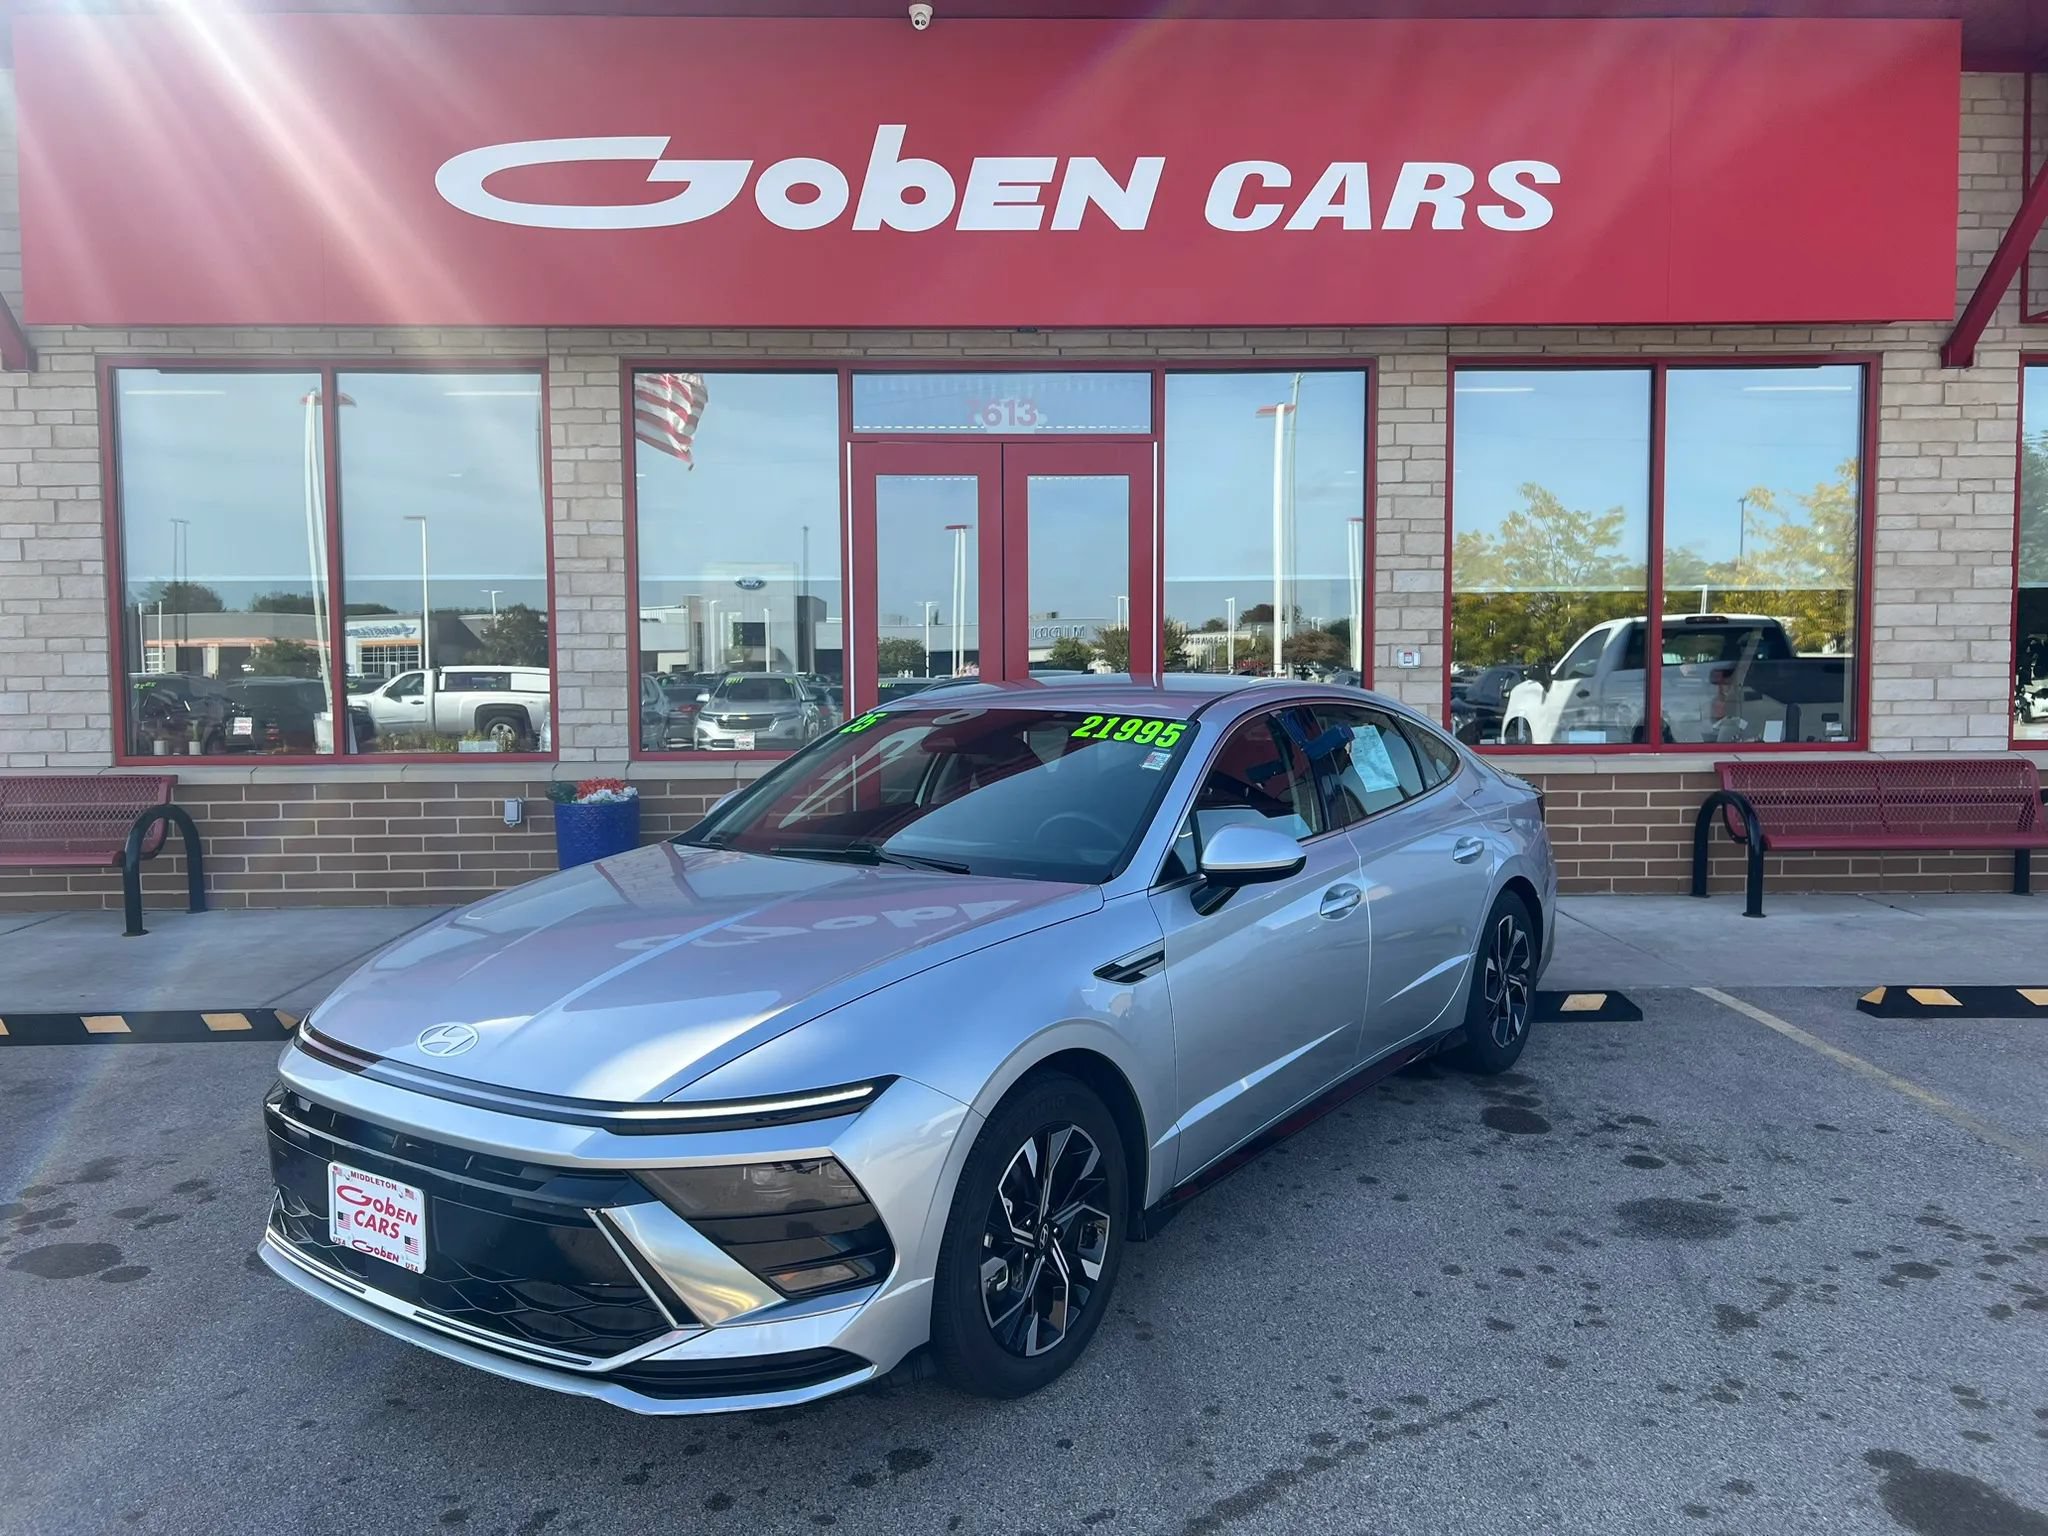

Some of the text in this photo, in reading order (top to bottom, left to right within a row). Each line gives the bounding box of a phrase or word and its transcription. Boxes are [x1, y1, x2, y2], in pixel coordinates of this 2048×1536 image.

[1203, 159, 1562, 232] CARS
[1071, 715, 1188, 748] 21995
[350, 1170, 397, 1191] MIDDLETON
[353, 1209, 401, 1239] CARS
